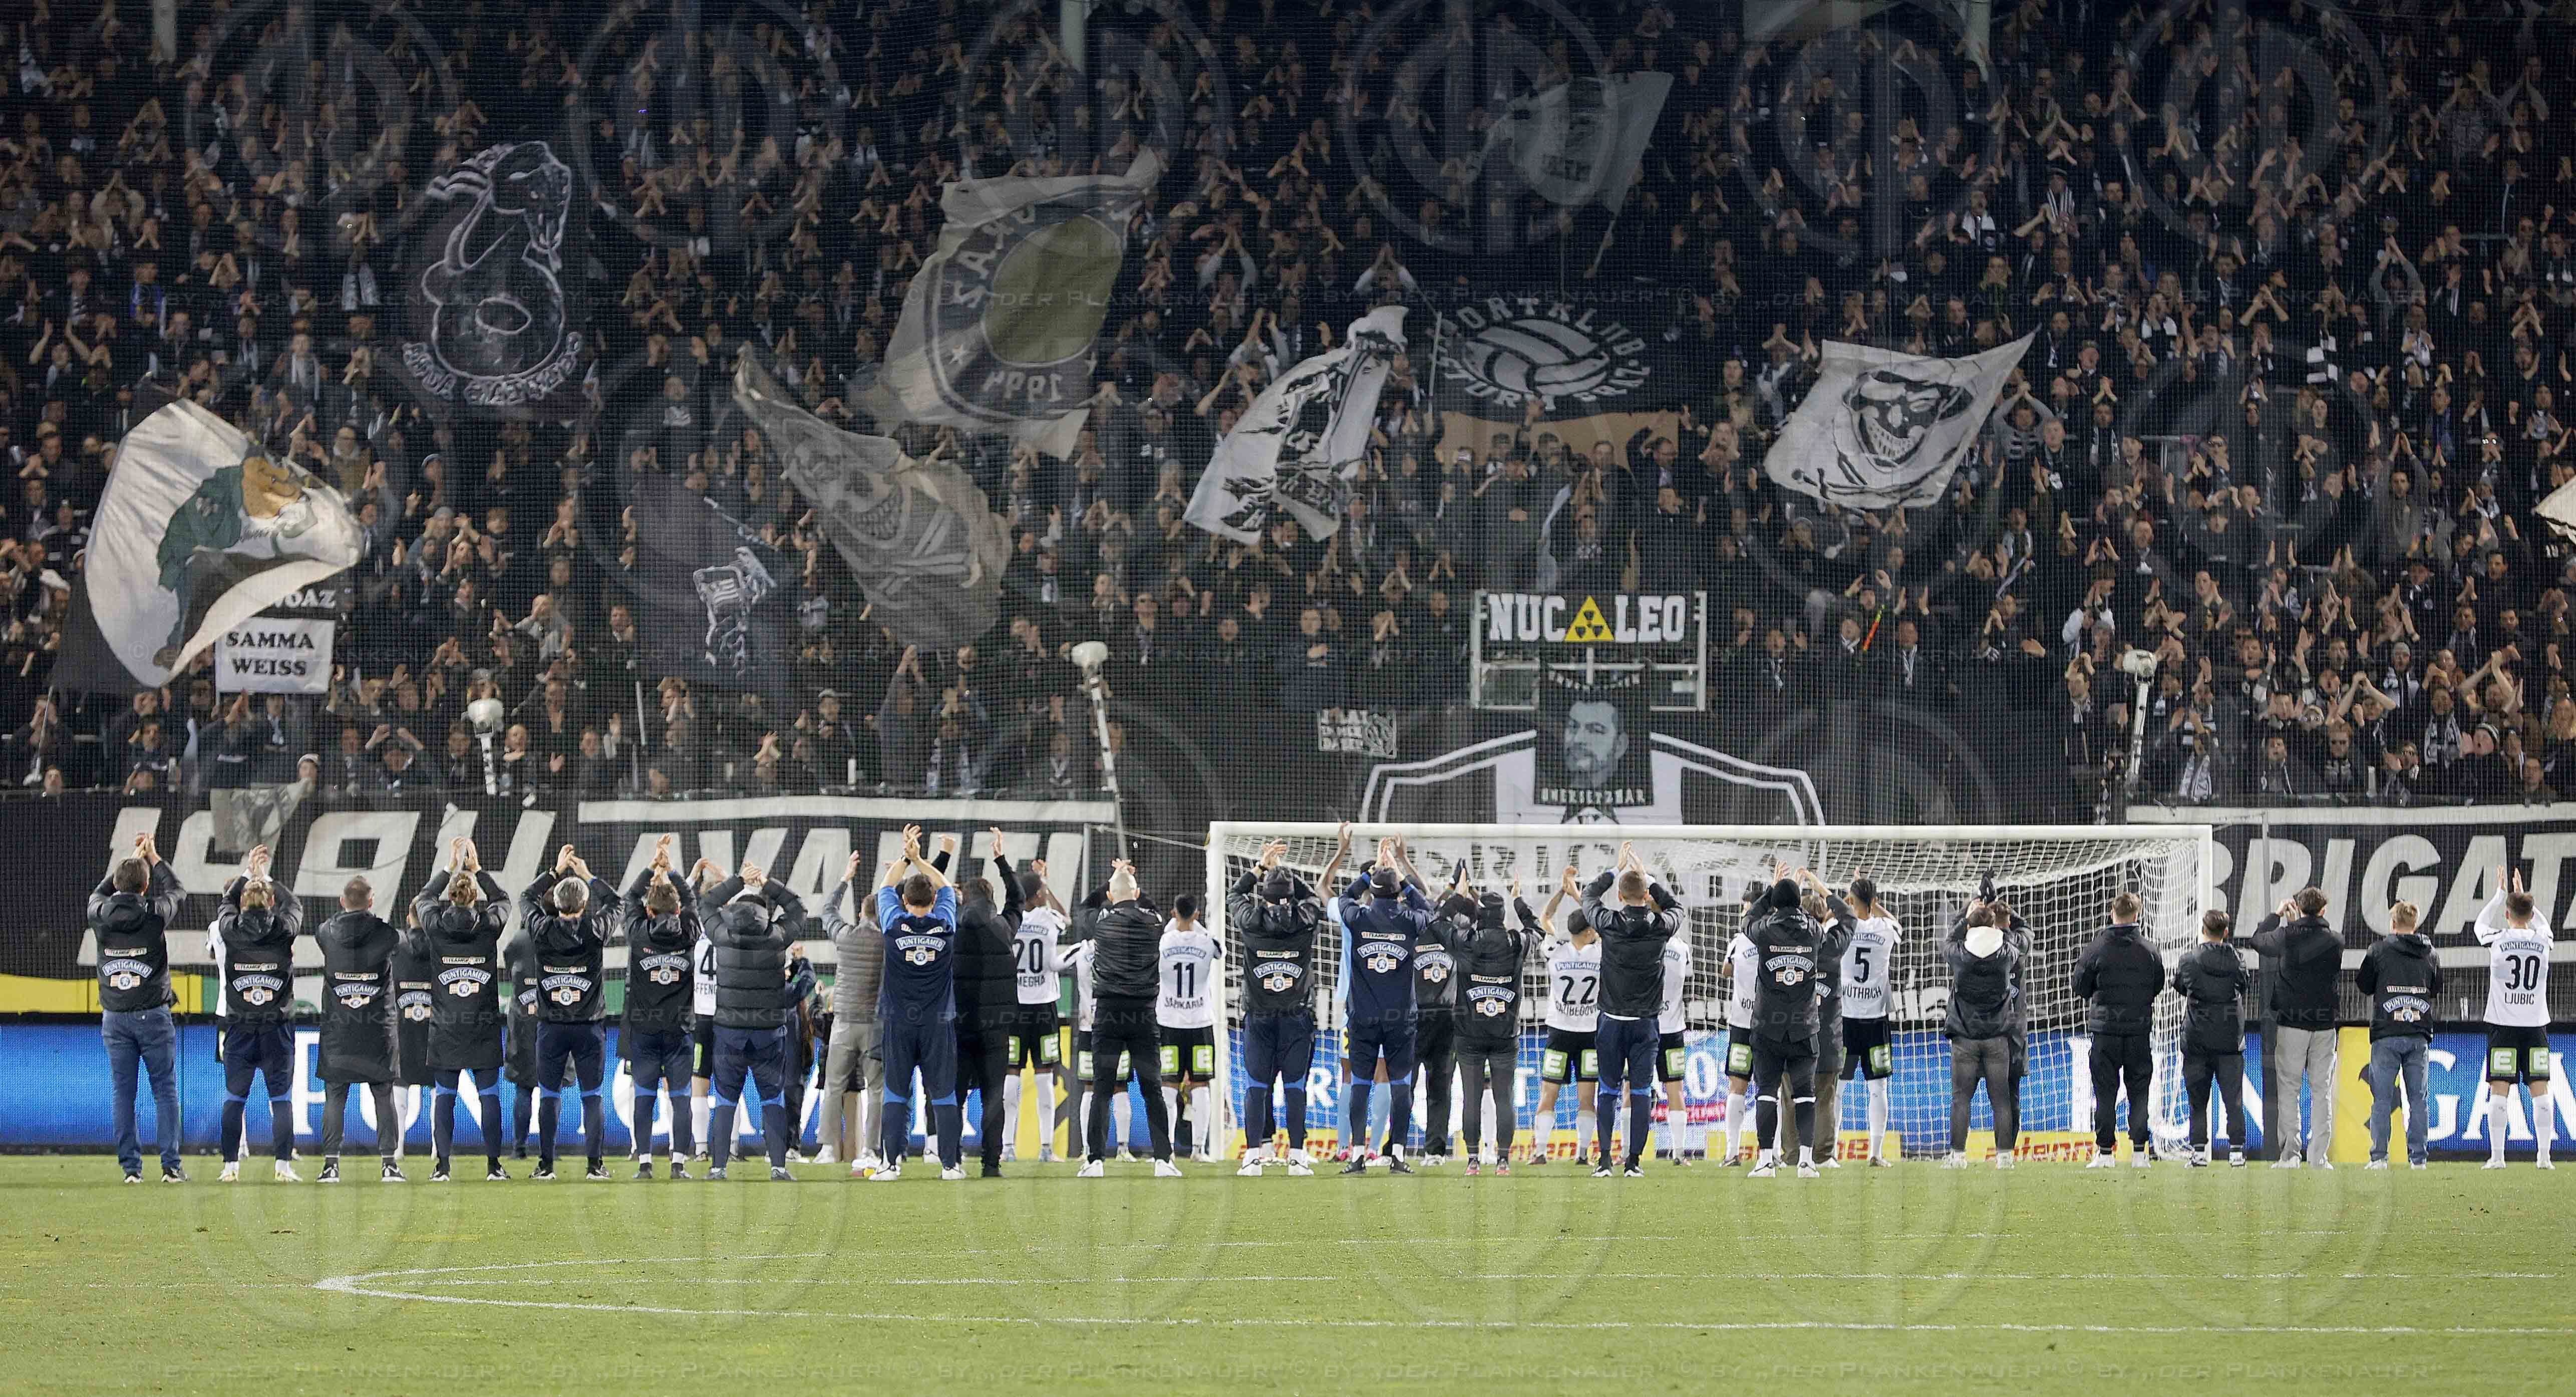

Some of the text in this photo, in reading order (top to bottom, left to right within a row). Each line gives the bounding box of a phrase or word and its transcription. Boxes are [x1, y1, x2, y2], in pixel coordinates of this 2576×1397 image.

[225, 631, 314, 649] SAMMA
[231, 658, 307, 676] WEISS
[2203, 832, 2576, 938] BRIGAT
[898, 936, 944, 951] PUNTIGAMER
[1359, 943, 1406, 960] PUNTIGAMER
[2500, 941, 2544, 953] PUNTIGAMER
[641, 956, 688, 970] PUNTIGAMER
[1013, 938, 1043, 973] 20
[1767, 955, 1812, 972] PUNTIGAMER
[105, 959, 150, 977] PUNTIGAMER
[1256, 962, 1300, 978] PUNTIGAMER
[1853, 946, 1871, 984] 5
[2505, 955, 2540, 990] 30
[234, 975, 281, 990] PUNTIGAMER
[442, 968, 489, 985] PUNTIGAMER
[545, 975, 588, 990] PUNTIGAMER
[1173, 962, 1194, 999] 11
[1468, 987, 1514, 1001] PUNTIGAMER
[1559, 976, 1596, 1004] 22
[2384, 996, 2429, 1013] PUNTIGAMER
[1079, 1051, 1093, 1074] E
[1197, 1048, 1212, 1069] E
[1545, 1051, 1563, 1074] E
[1731, 1046, 1749, 1067] E
[2494, 1050, 2512, 1070] E
[2533, 1050, 2549, 1070] E
